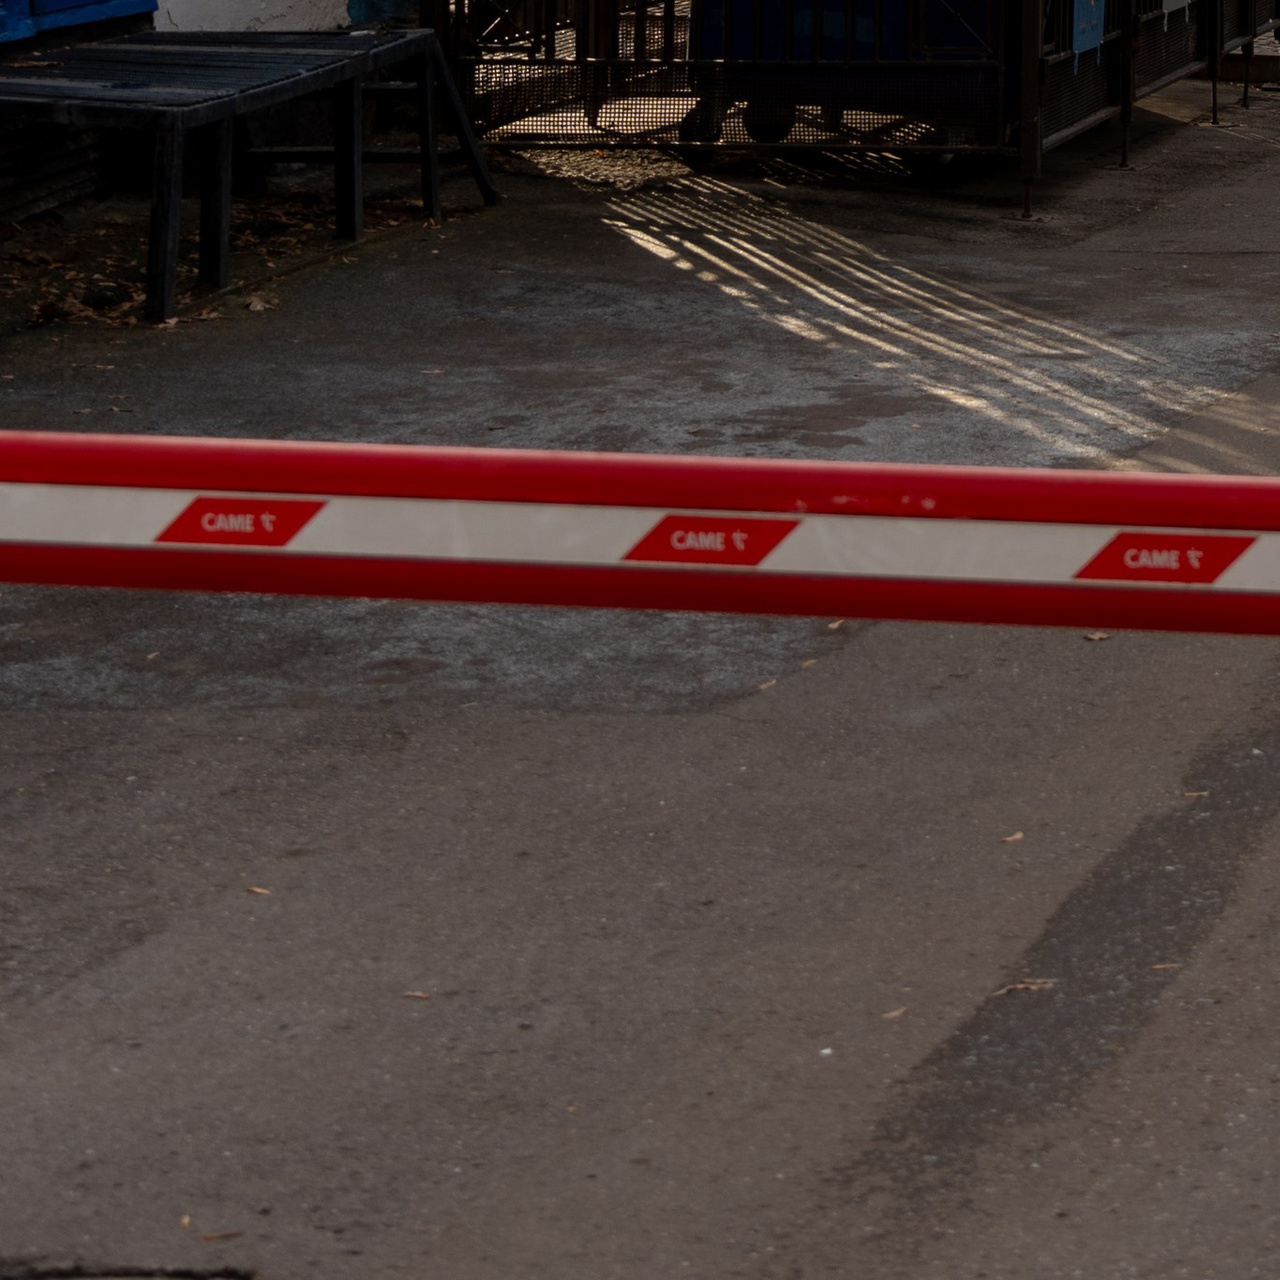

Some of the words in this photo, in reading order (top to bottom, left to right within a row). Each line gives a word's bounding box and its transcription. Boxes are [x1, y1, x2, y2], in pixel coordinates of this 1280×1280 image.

[200, 512, 255, 533] CAME
[670, 529, 726, 552] CAME
[1123, 547, 1181, 570] CAME
